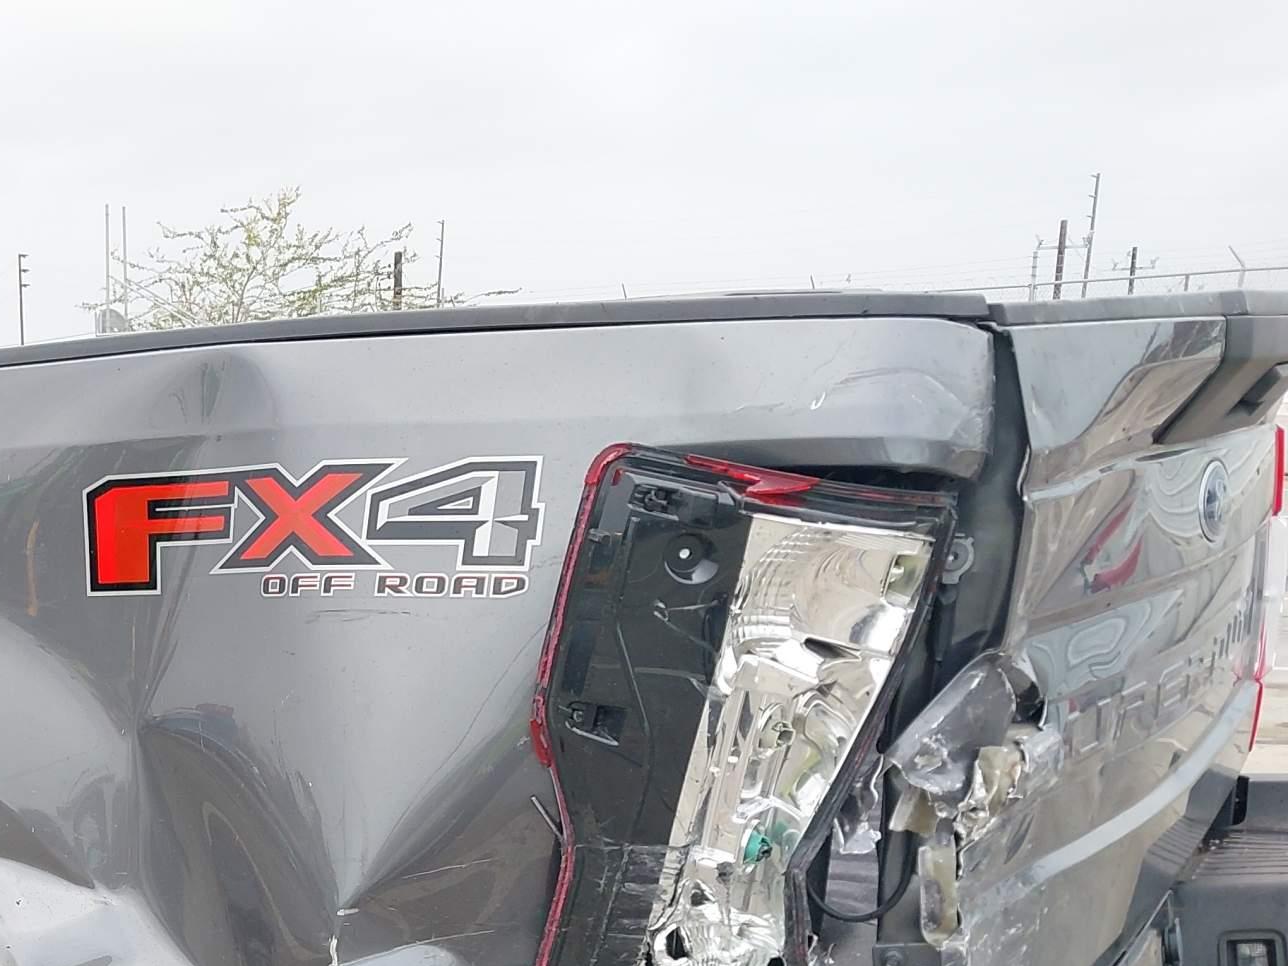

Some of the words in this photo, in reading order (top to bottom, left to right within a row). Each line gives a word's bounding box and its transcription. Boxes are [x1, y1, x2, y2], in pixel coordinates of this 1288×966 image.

[83, 456, 544, 596] FX4
[261, 572, 355, 597] OFF
[376, 572, 529, 598] ROAD
